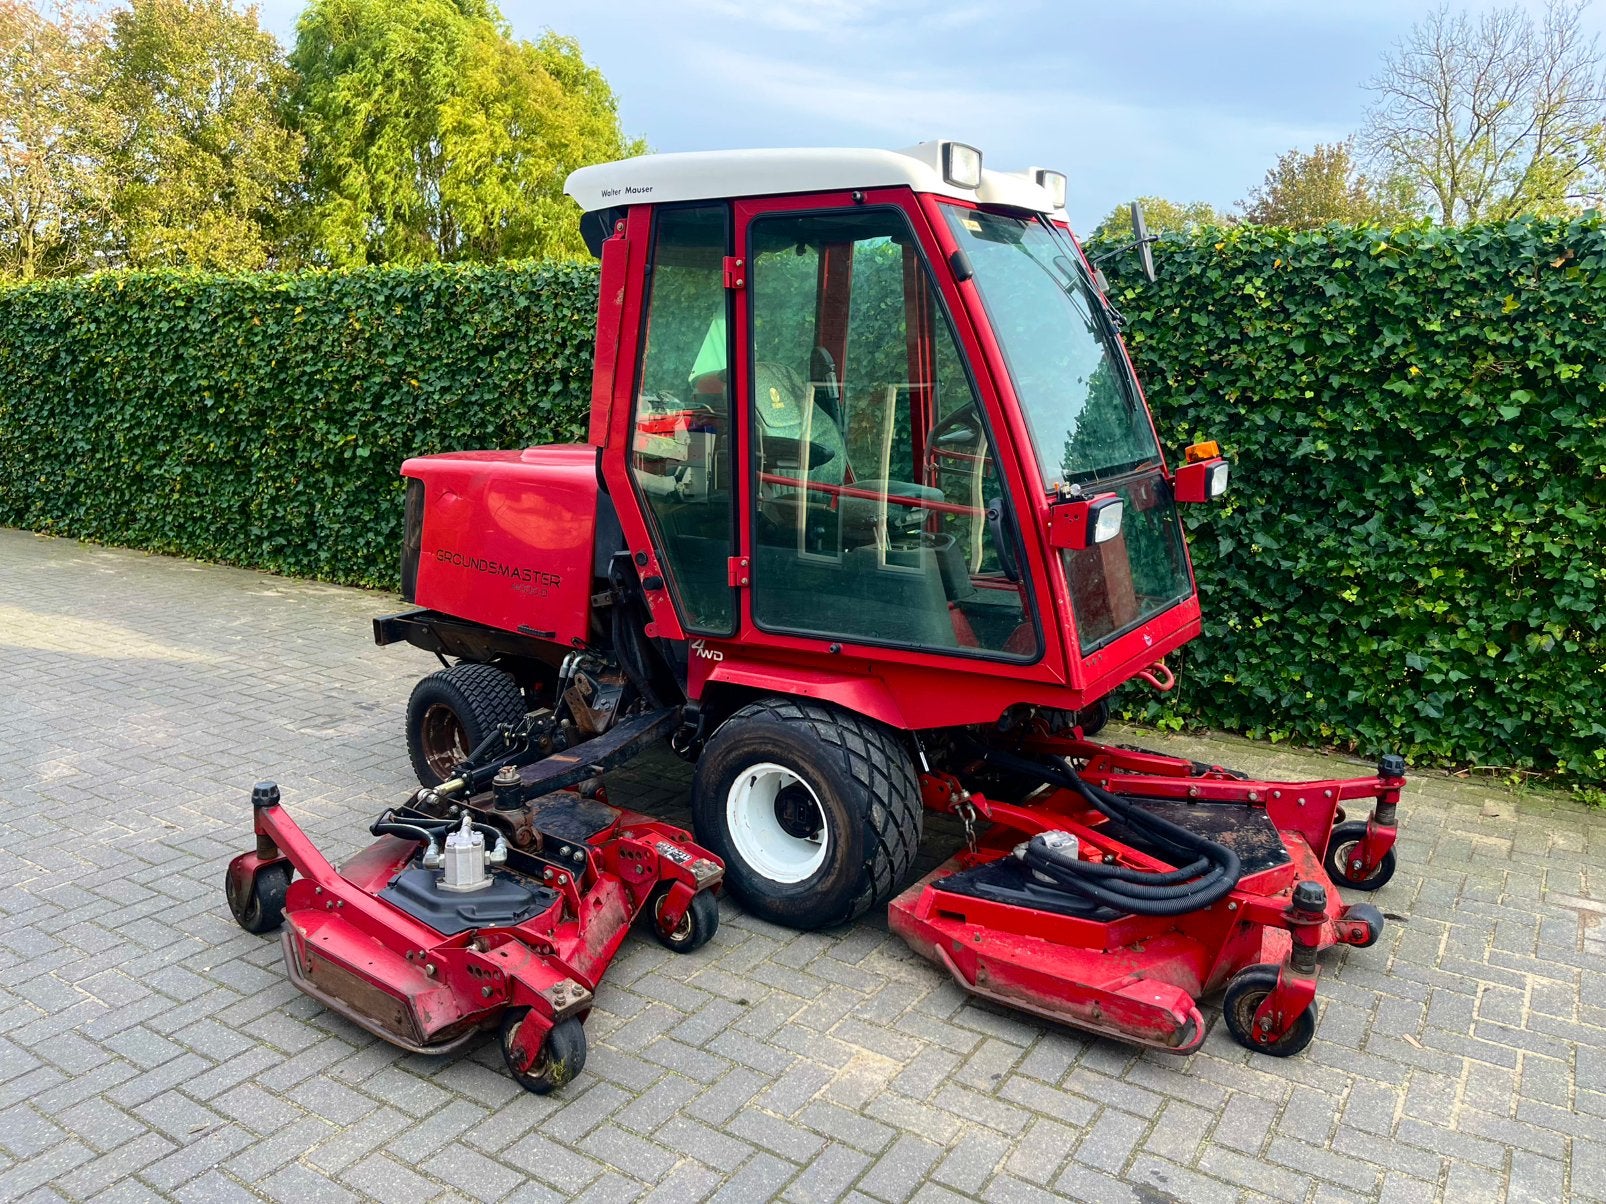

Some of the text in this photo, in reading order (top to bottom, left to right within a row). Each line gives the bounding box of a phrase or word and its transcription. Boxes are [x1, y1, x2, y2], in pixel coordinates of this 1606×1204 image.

[601, 186, 653, 198] Walter Mauser
[436, 549, 561, 588] GROUNDSMASTER
[691, 639, 724, 661] 4WD
